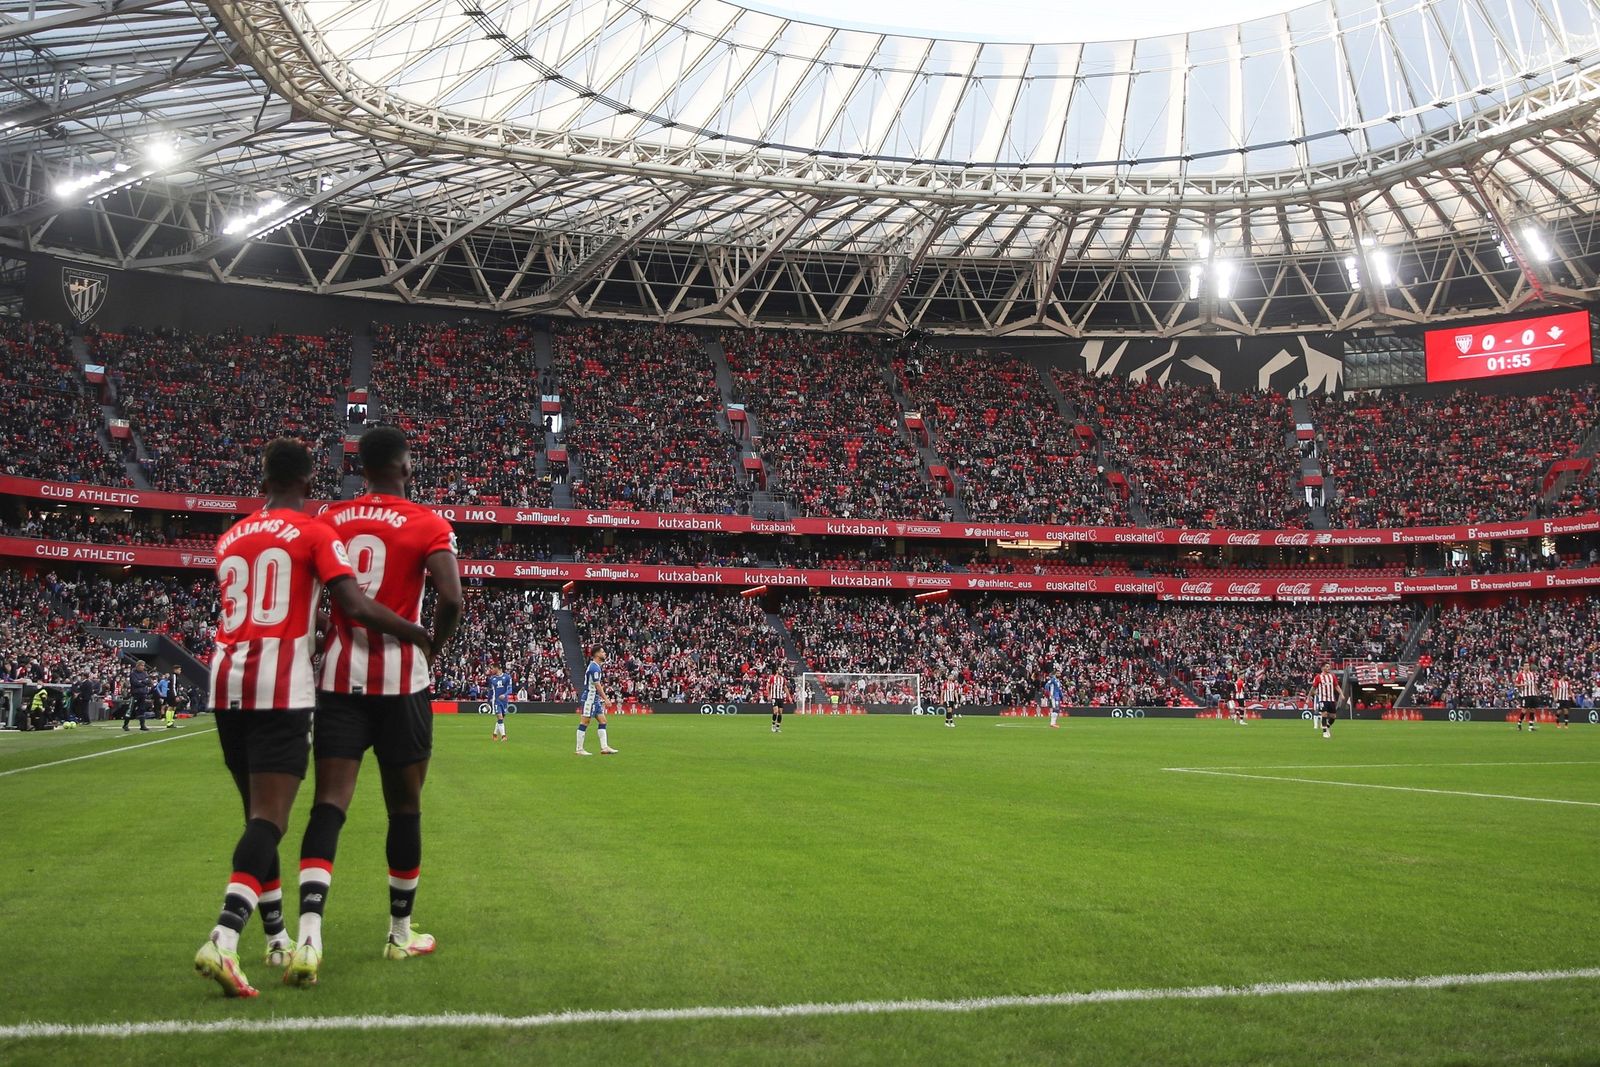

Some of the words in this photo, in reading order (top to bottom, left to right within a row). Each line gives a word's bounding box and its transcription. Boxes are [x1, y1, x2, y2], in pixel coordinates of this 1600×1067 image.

[1481, 334, 1496, 351] 0
[1521, 329, 1535, 346] 0
[1487, 353, 1531, 371] 01:55
[41, 485, 74, 498] CLUB
[79, 490, 139, 504] ATHLETIC
[333, 506, 408, 529] WILLIAMS
[432, 509, 456, 522] MQ
[465, 510, 497, 522] IMQ
[658, 517, 722, 530] kutxabank
[751, 522, 796, 532] kutxabank
[827, 523, 888, 535] kutxabank
[1582, 522, 1599, 530] brand
[218, 519, 285, 555] WILLIAMS
[276, 522, 301, 543] JR
[974, 528, 1029, 538] @athletic_eus
[1046, 530, 1088, 540] euskaltel
[1115, 532, 1155, 542] euskaltel
[1435, 533, 1456, 541] brand
[1509, 528, 1529, 536] brand
[1349, 536, 1381, 544] balance
[36, 545, 69, 557] CLUB
[74, 549, 135, 562] ATHLETIC
[346, 534, 387, 600] 9
[464, 565, 496, 576] IMQ
[658, 570, 722, 582] kutxabank
[744, 572, 808, 584] kutxabank
[830, 574, 892, 586] kutxabank
[977, 579, 1032, 589] @athletic_eus
[1046, 580, 1088, 591] euskaltel
[1115, 582, 1155, 592] euskaltel
[1355, 585, 1387, 593] balance
[1436, 583, 1457, 591] brand
[218, 547, 292, 634] 30
[107, 637, 148, 648] txabank
